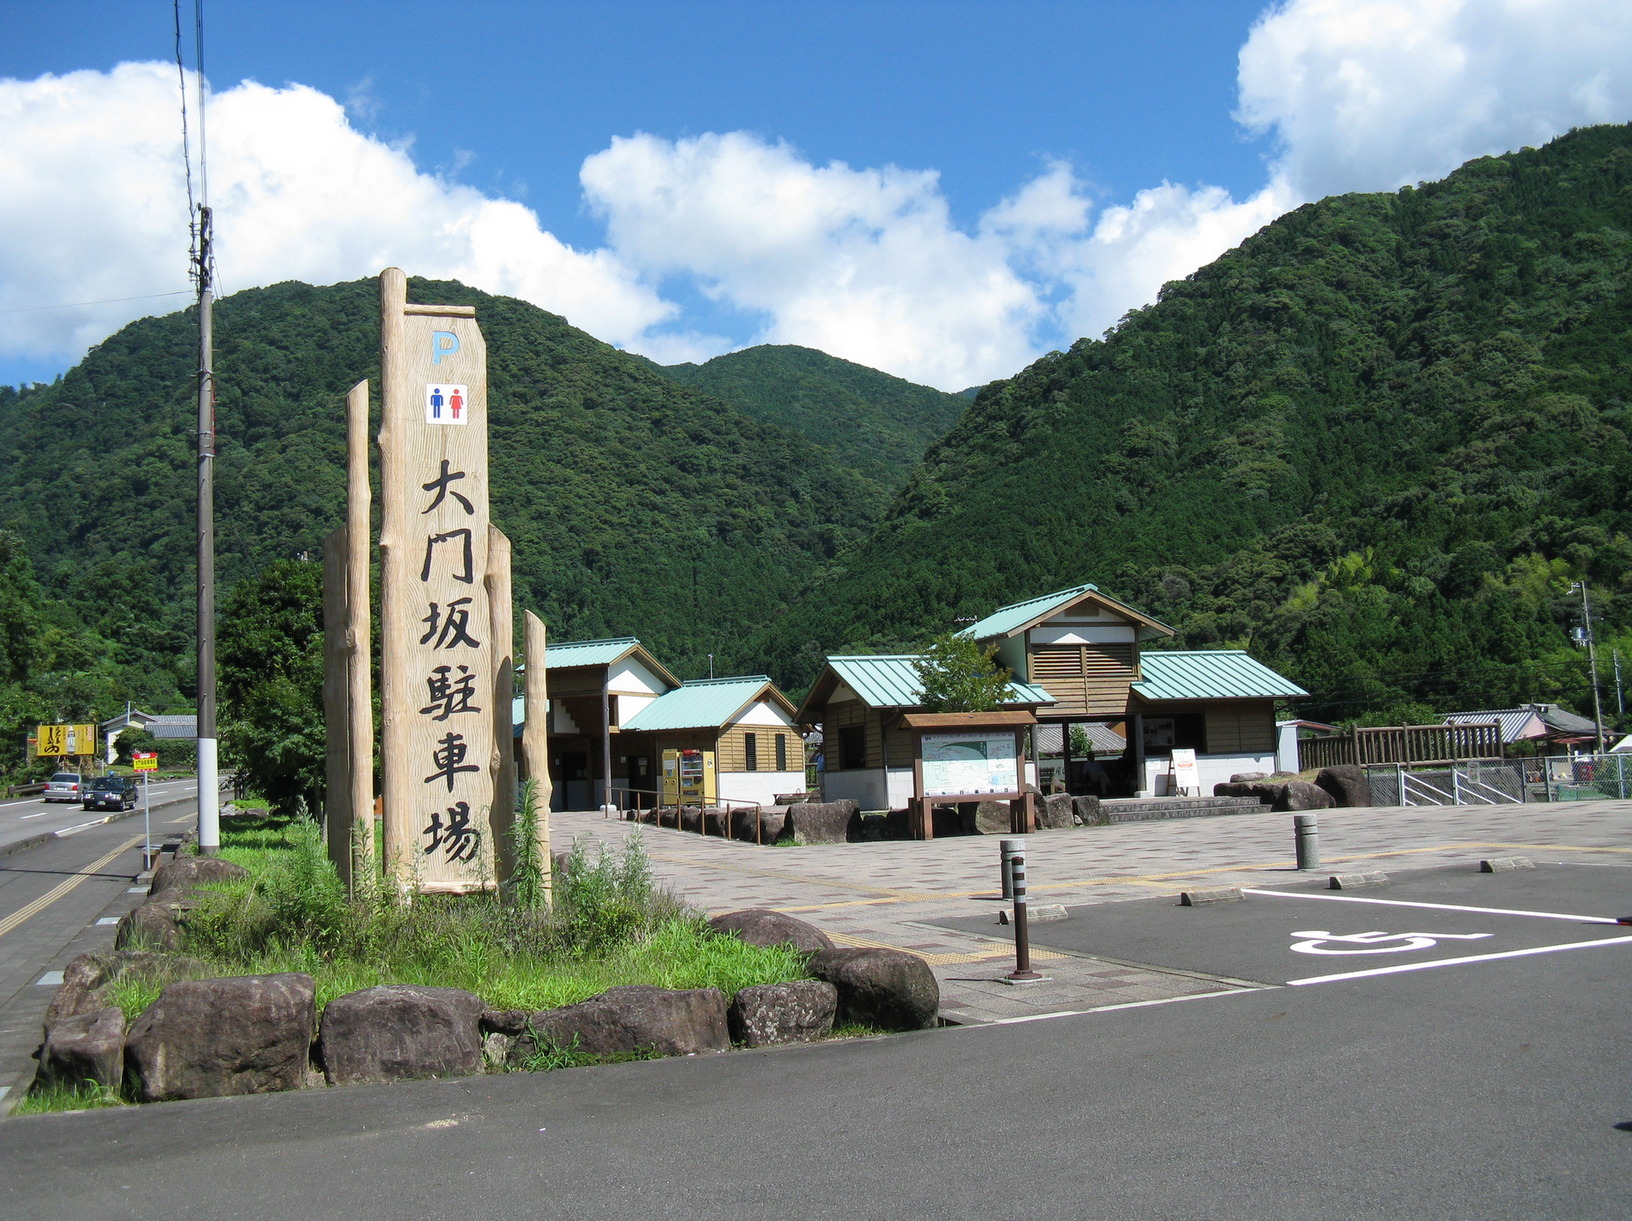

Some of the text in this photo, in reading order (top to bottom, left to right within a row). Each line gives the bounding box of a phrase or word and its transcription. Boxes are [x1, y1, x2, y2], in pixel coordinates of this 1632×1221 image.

[432, 331, 460, 365] P
[420, 459, 482, 864] 大門坂駐車場
